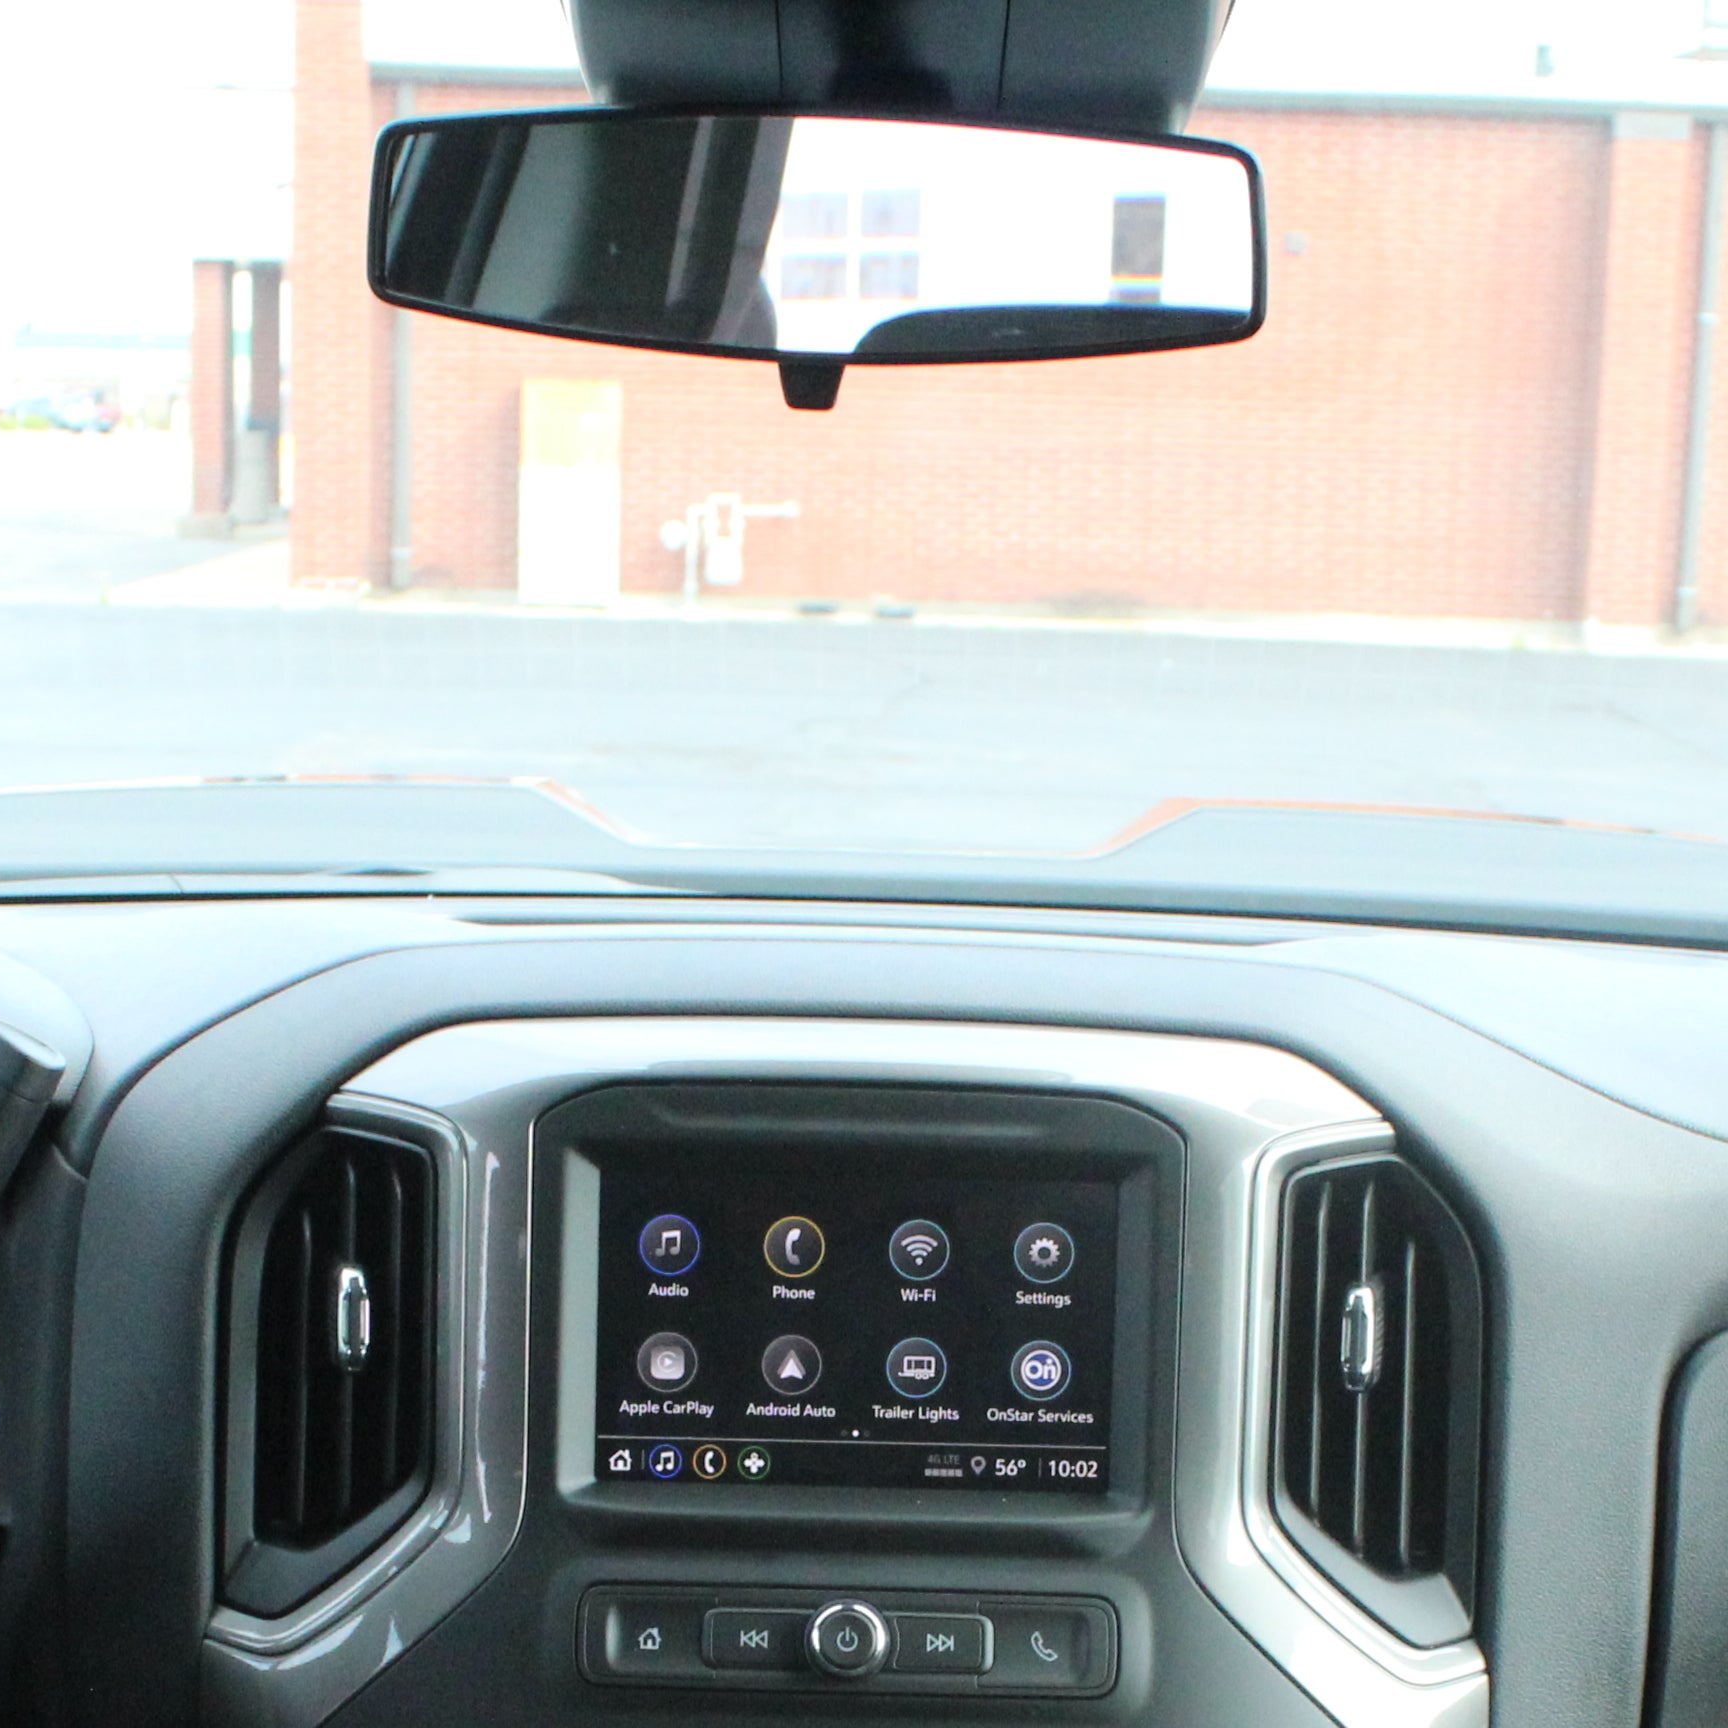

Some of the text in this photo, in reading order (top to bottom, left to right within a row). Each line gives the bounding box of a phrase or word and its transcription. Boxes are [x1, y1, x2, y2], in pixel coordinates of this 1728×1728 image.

[648, 1283, 690, 1297] Audio
[772, 1285, 816, 1300] Phone
[901, 1288, 936, 1301] Wi-Fi
[1015, 1290, 1072, 1308] Settings
[619, 1400, 714, 1418] Apple CarPlay
[746, 1403, 836, 1418] Android Auto
[872, 1405, 960, 1423] Trailer Lights
[986, 1408, 1094, 1424] OnStar Services
[1048, 1460, 1098, 1478] 10:02
